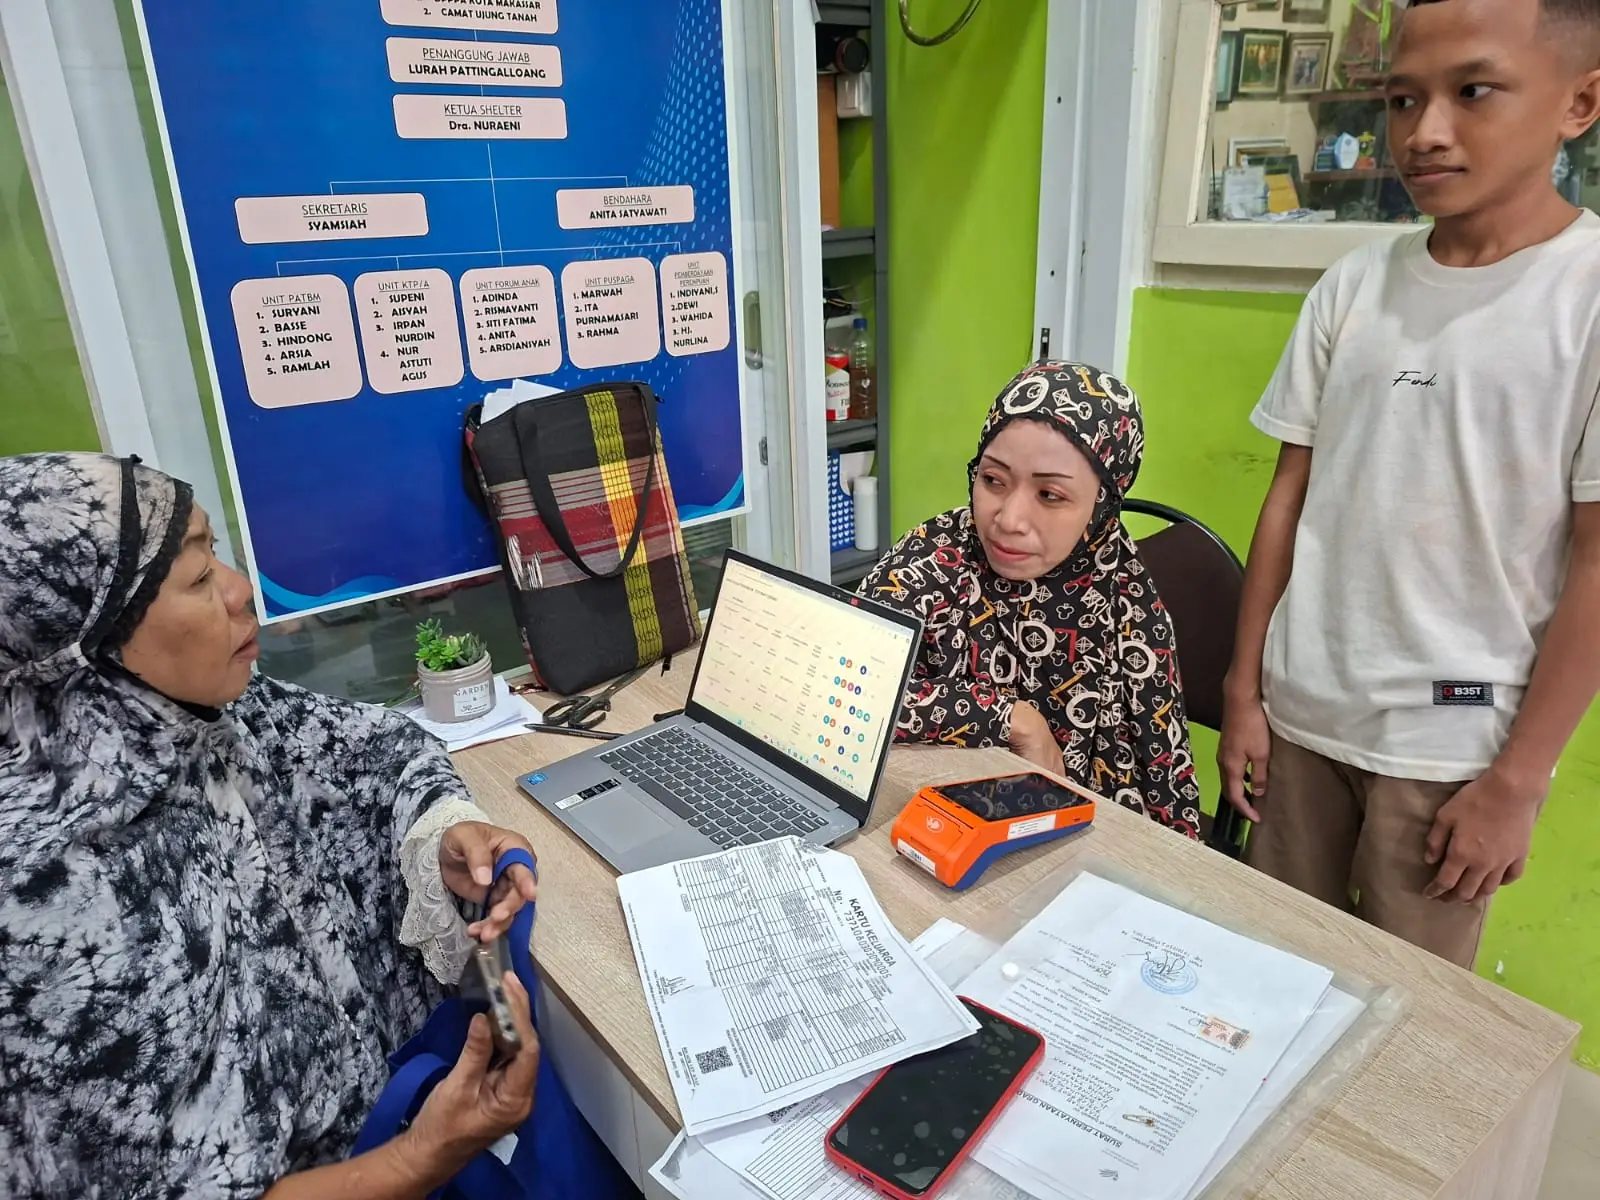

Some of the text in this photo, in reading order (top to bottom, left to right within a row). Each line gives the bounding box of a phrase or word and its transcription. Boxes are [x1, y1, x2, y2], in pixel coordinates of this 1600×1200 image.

[424, 8, 537, 22] 2. CAMAT UJUNG TANAH
[423, 48, 530, 63] PENANGGUNG JAWAB
[409, 64, 546, 78] LURAH PATTINGALLOANG
[444, 104, 522, 115] KETUA SHELTER
[449, 121, 520, 130] Dra. NURAENI
[603, 195, 652, 205] BENDAHARA
[302, 203, 368, 216] SEKRETARIS
[589, 208, 667, 220] ANITA SATYAWATI
[308, 220, 367, 231] SYAMSIAH
[378, 280, 429, 290] UNIT KTP/A
[475, 278, 540, 289] UNIT FORUM ANAK
[584, 276, 634, 287] UNIT PUSPAGA
[262, 293, 320, 305] UNIT PATBM
[389, 293, 425, 303] SUPENI
[481, 293, 518, 302] ADINDA
[581, 288, 622, 299] MARWAH
[256, 306, 320, 320] 1. SURYANI
[373, 306, 428, 318] 2. AISYAH
[485, 304, 538, 315] RISMAYANTI
[584, 303, 598, 312] ITA
[486, 319, 501, 328] SITI
[503, 317, 536, 327] FATIMA
[576, 313, 639, 325] PURNAMASARI
[680, 312, 713, 322] WAHIDA
[259, 321, 307, 334] 2. BASSE
[393, 319, 425, 330] IRPAN
[395, 332, 435, 343] NURDIN
[488, 330, 516, 341] ANITA
[577, 327, 619, 339] 3. RAHMA
[262, 333, 332, 348] 3. HINDONG
[489, 339, 550, 353] ARSDIANSYAH
[674, 336, 708, 347] NURLINA
[280, 349, 312, 361] ARSIA
[380, 347, 418, 358] 4. NUR
[267, 360, 330, 375] 5. RAMLAH
[399, 358, 432, 369] ASTUTI
[401, 372, 427, 382] AGUS
[833, 890, 843, 905] No.
[849, 898, 871, 928] KARTU
[864, 929, 896, 967] KELUARGA
[1038, 1101, 1093, 1133] PERNYATAAN
[1093, 1131, 1122, 1148] SURAT
